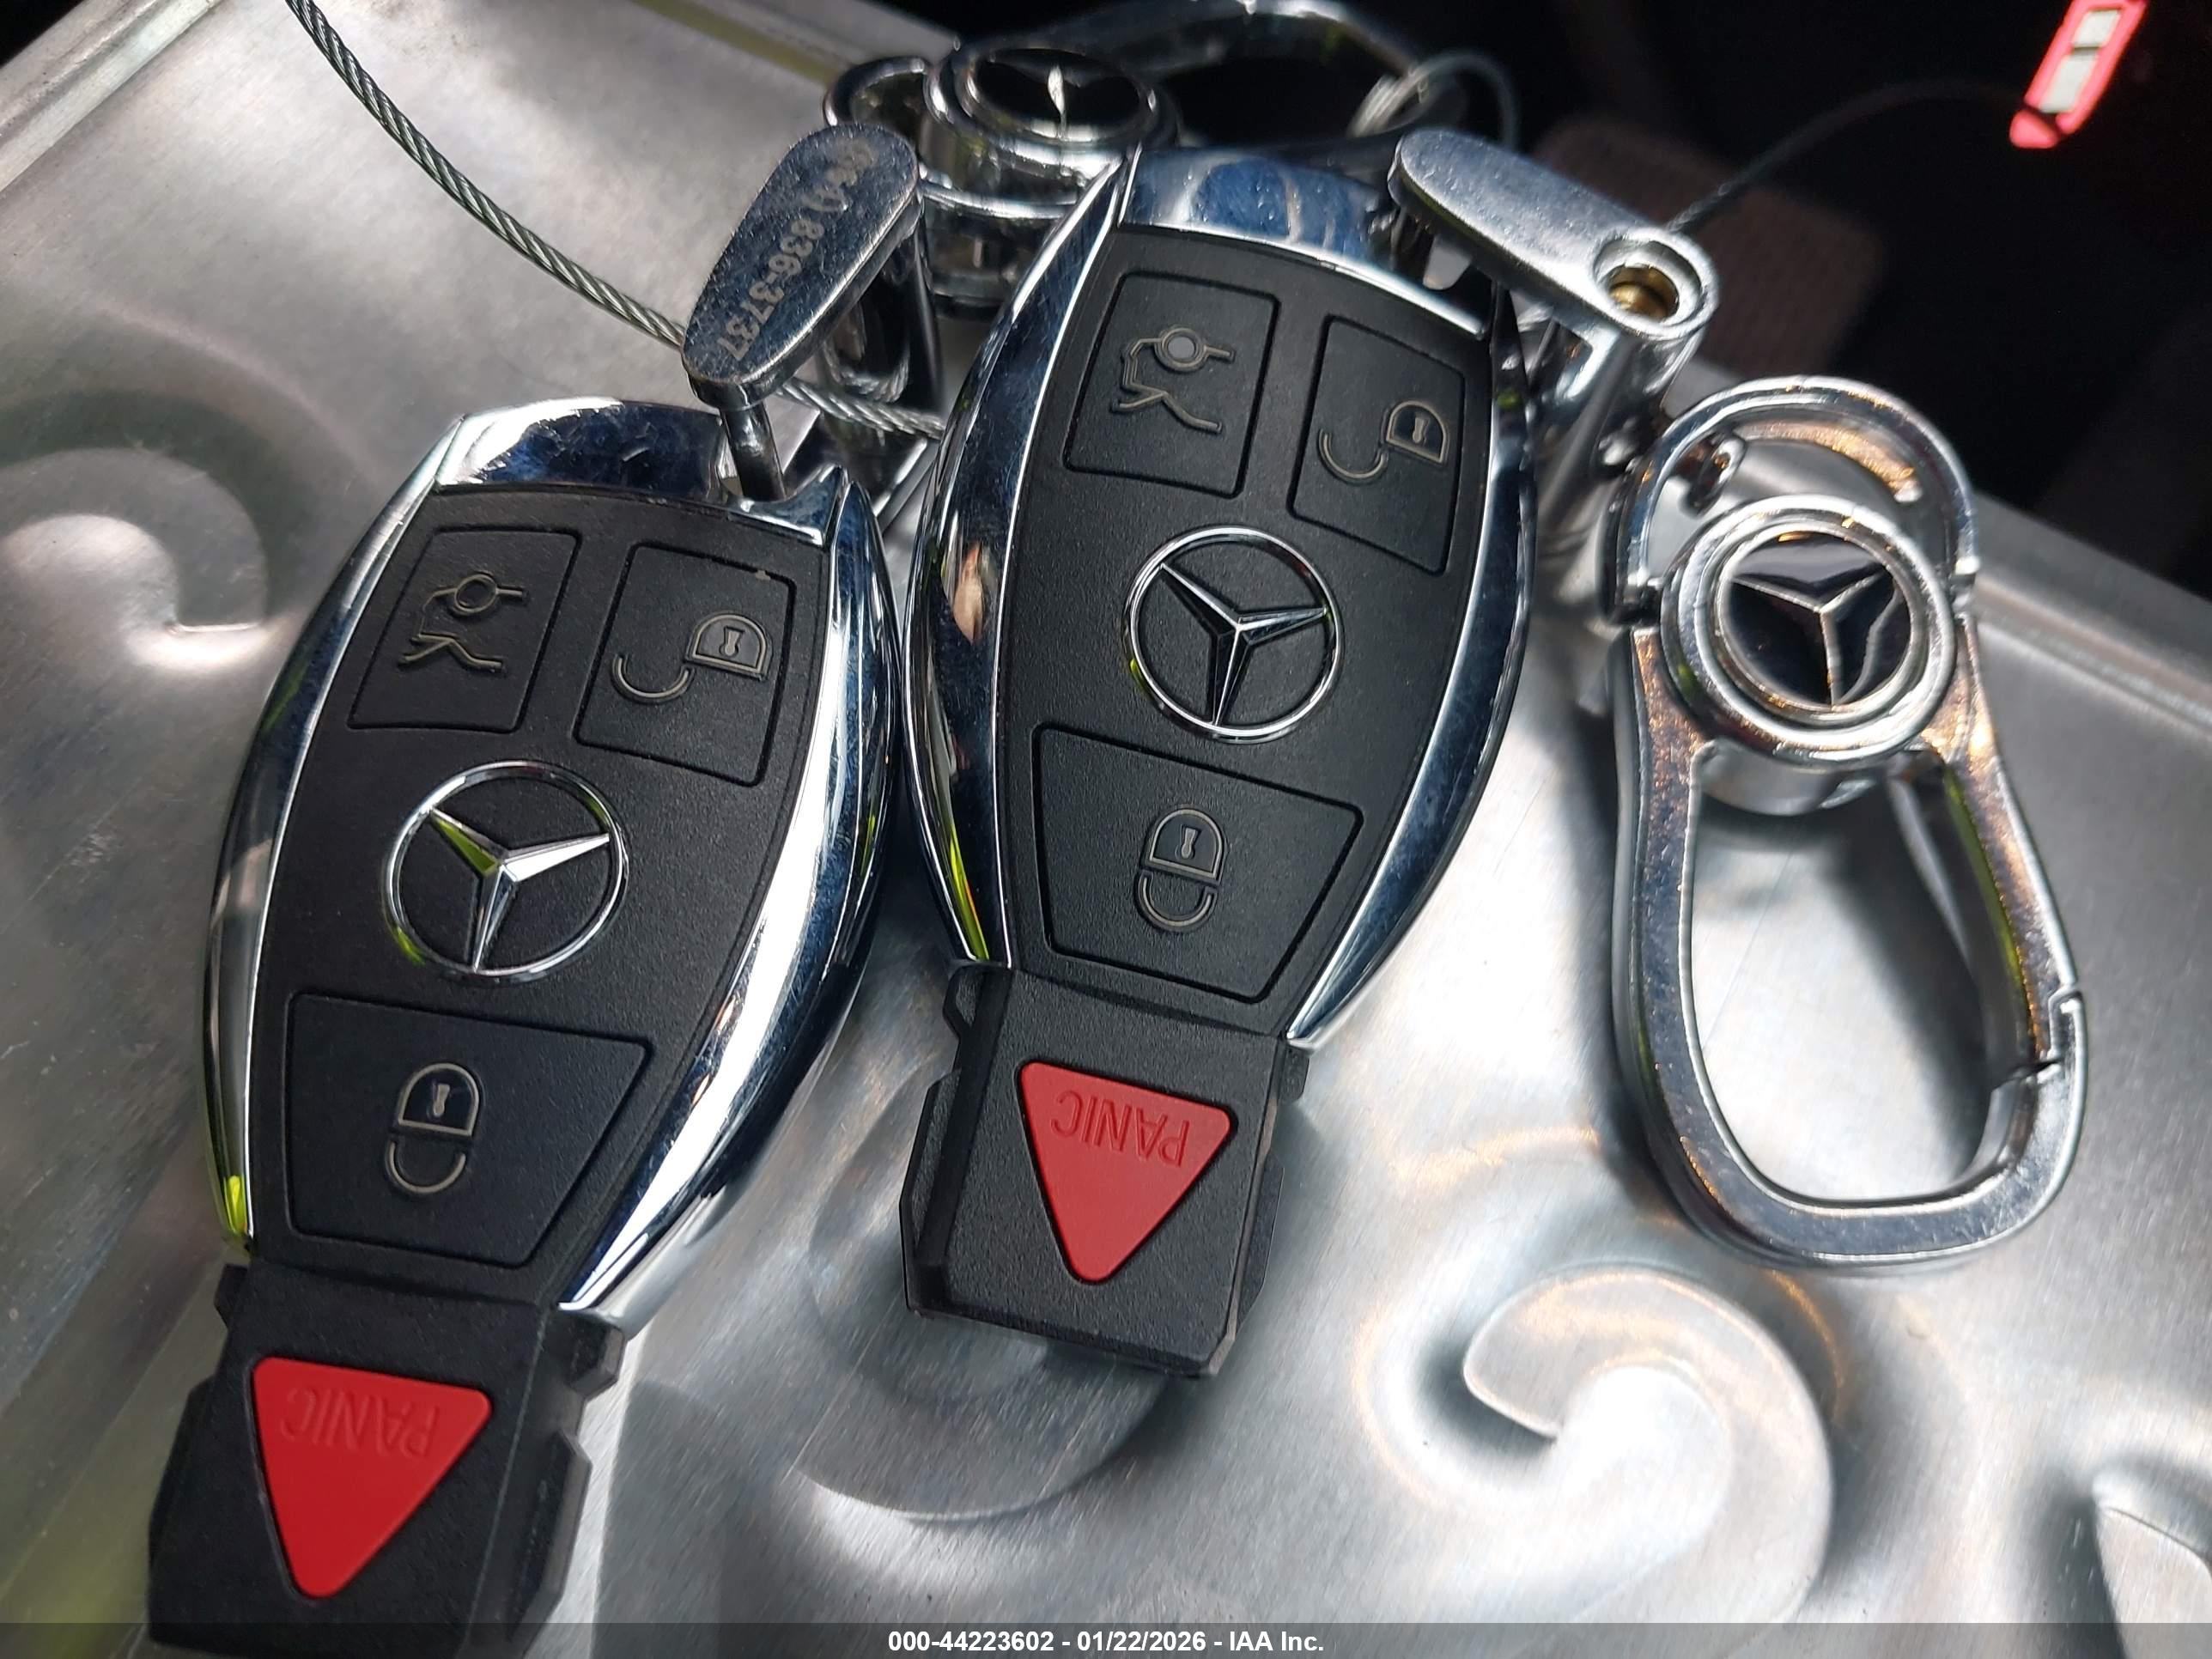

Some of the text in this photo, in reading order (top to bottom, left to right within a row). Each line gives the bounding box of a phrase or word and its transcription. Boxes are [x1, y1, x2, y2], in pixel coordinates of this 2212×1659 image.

[717, 218, 825, 362] 836-3737
[1050, 1089, 1191, 1168] PANIC
[279, 1387, 441, 1460] PANIC
